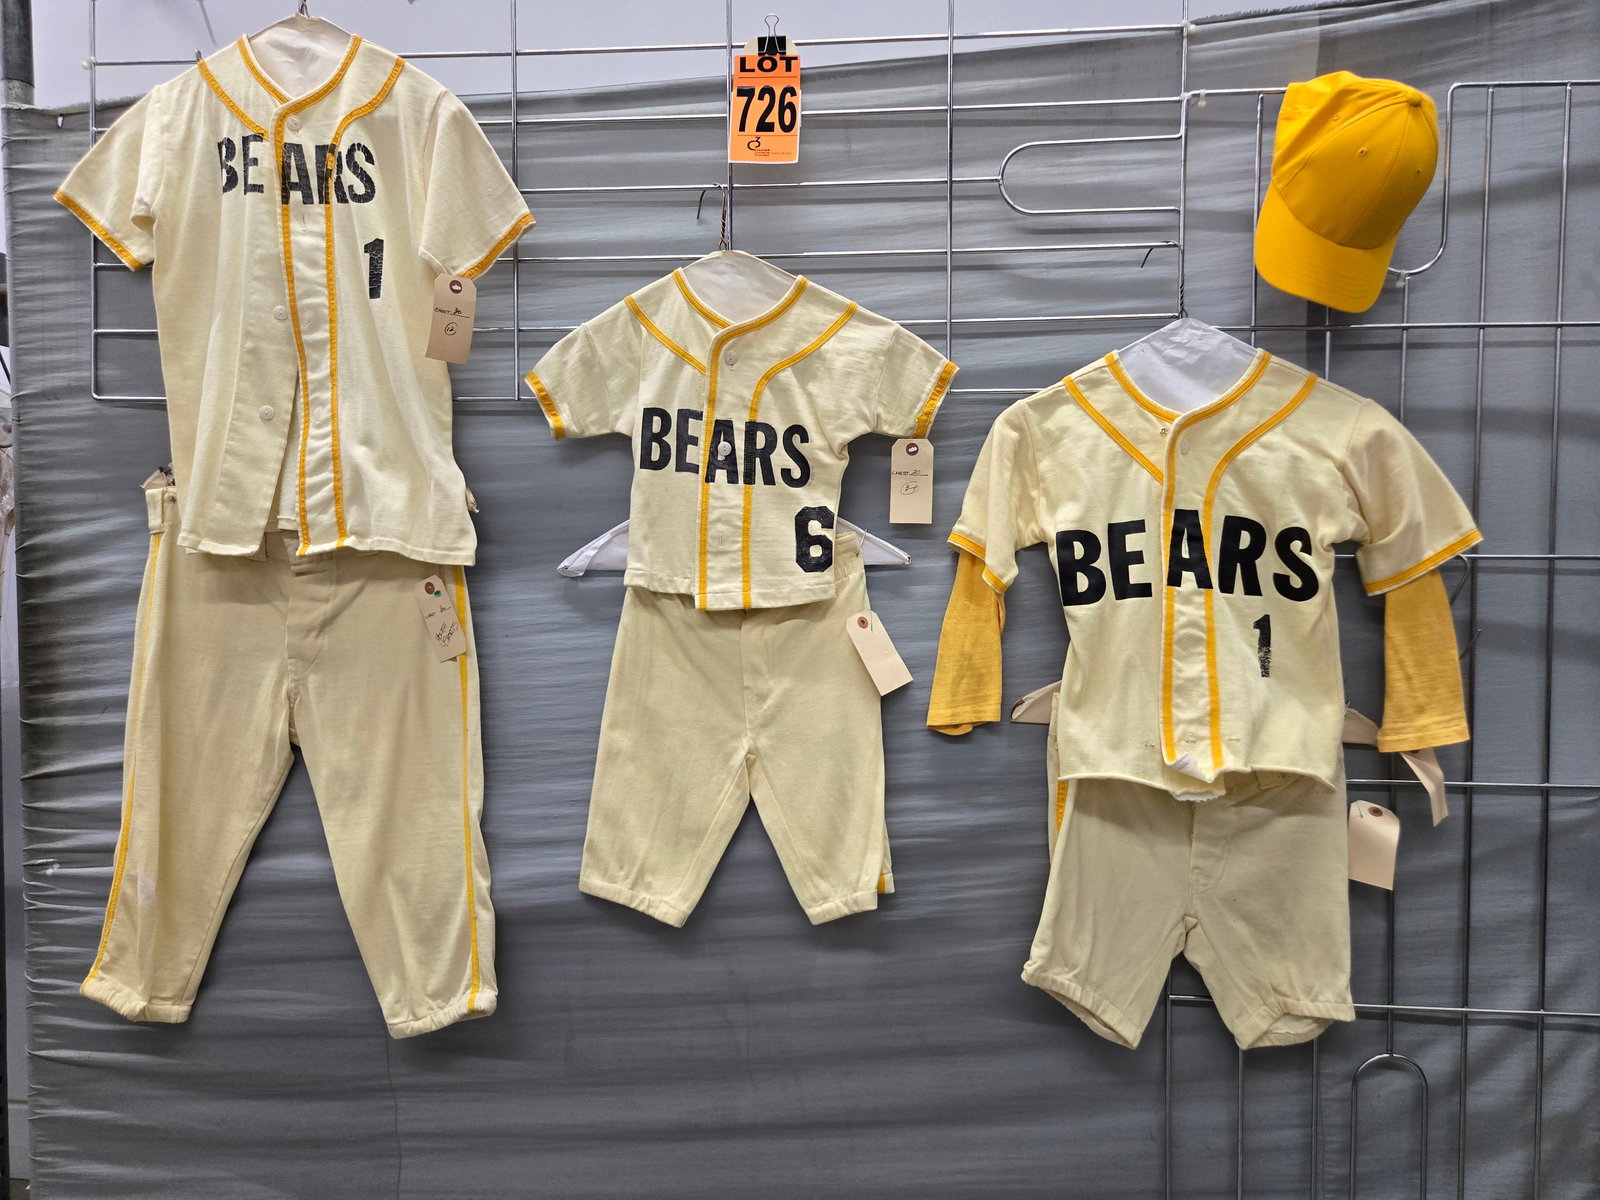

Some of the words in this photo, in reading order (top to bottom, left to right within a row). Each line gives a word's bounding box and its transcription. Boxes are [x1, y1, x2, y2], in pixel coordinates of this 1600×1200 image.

[739, 56, 798, 73] LOT
[736, 85, 797, 133] 726
[217, 133, 376, 205] BEARS
[363, 238, 385, 299] 1
[640, 407, 811, 488] BEARS
[794, 506, 835, 573] 6
[1056, 509, 1319, 607] BEARS
[1253, 613, 1272, 678] 1
